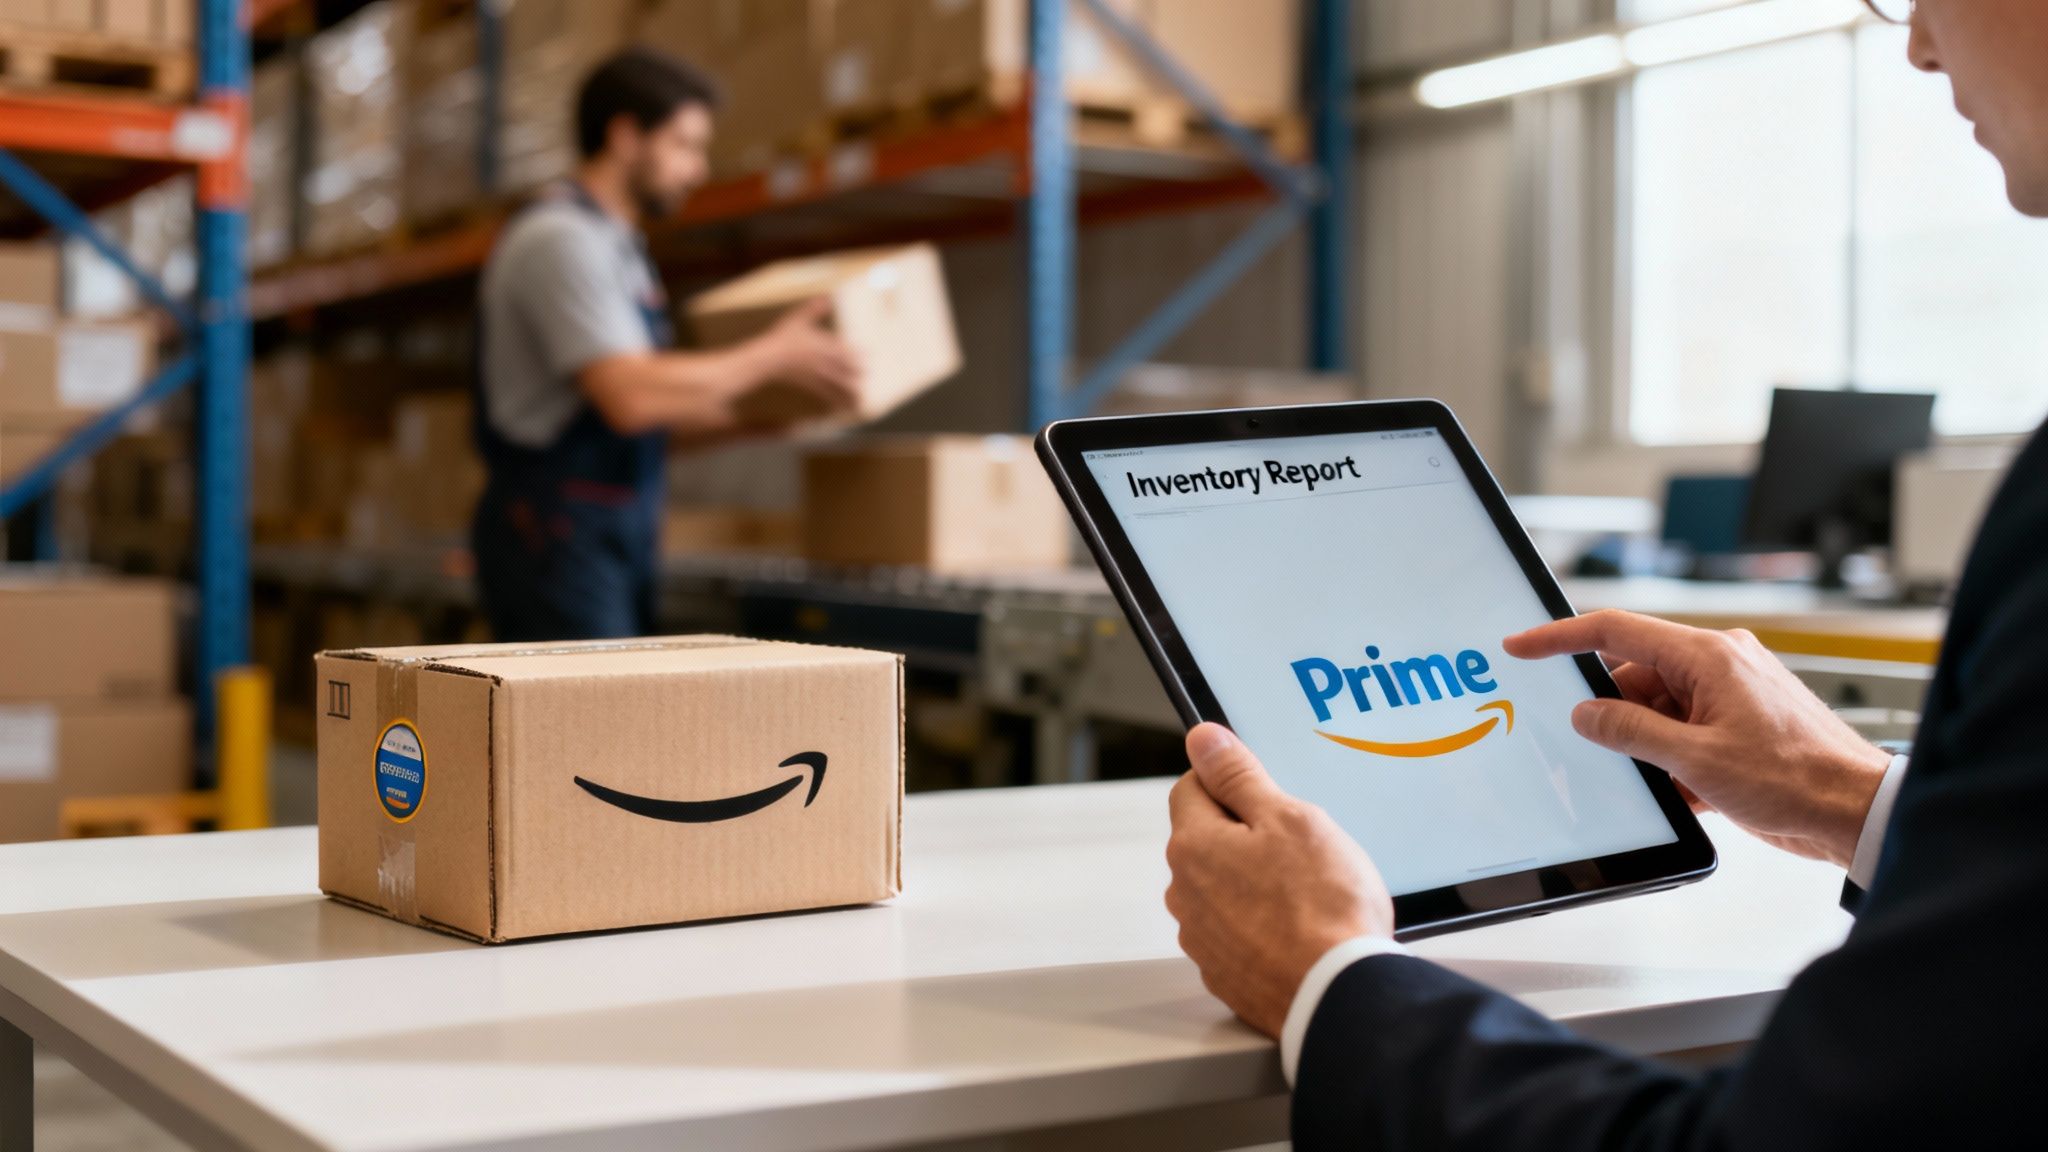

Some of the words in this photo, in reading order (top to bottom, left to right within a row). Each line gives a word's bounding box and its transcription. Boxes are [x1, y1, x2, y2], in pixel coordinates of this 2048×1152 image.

[1126, 466, 1260, 498] Inventory
[1263, 456, 1362, 492] Report
[1290, 645, 1498, 723] Prime
